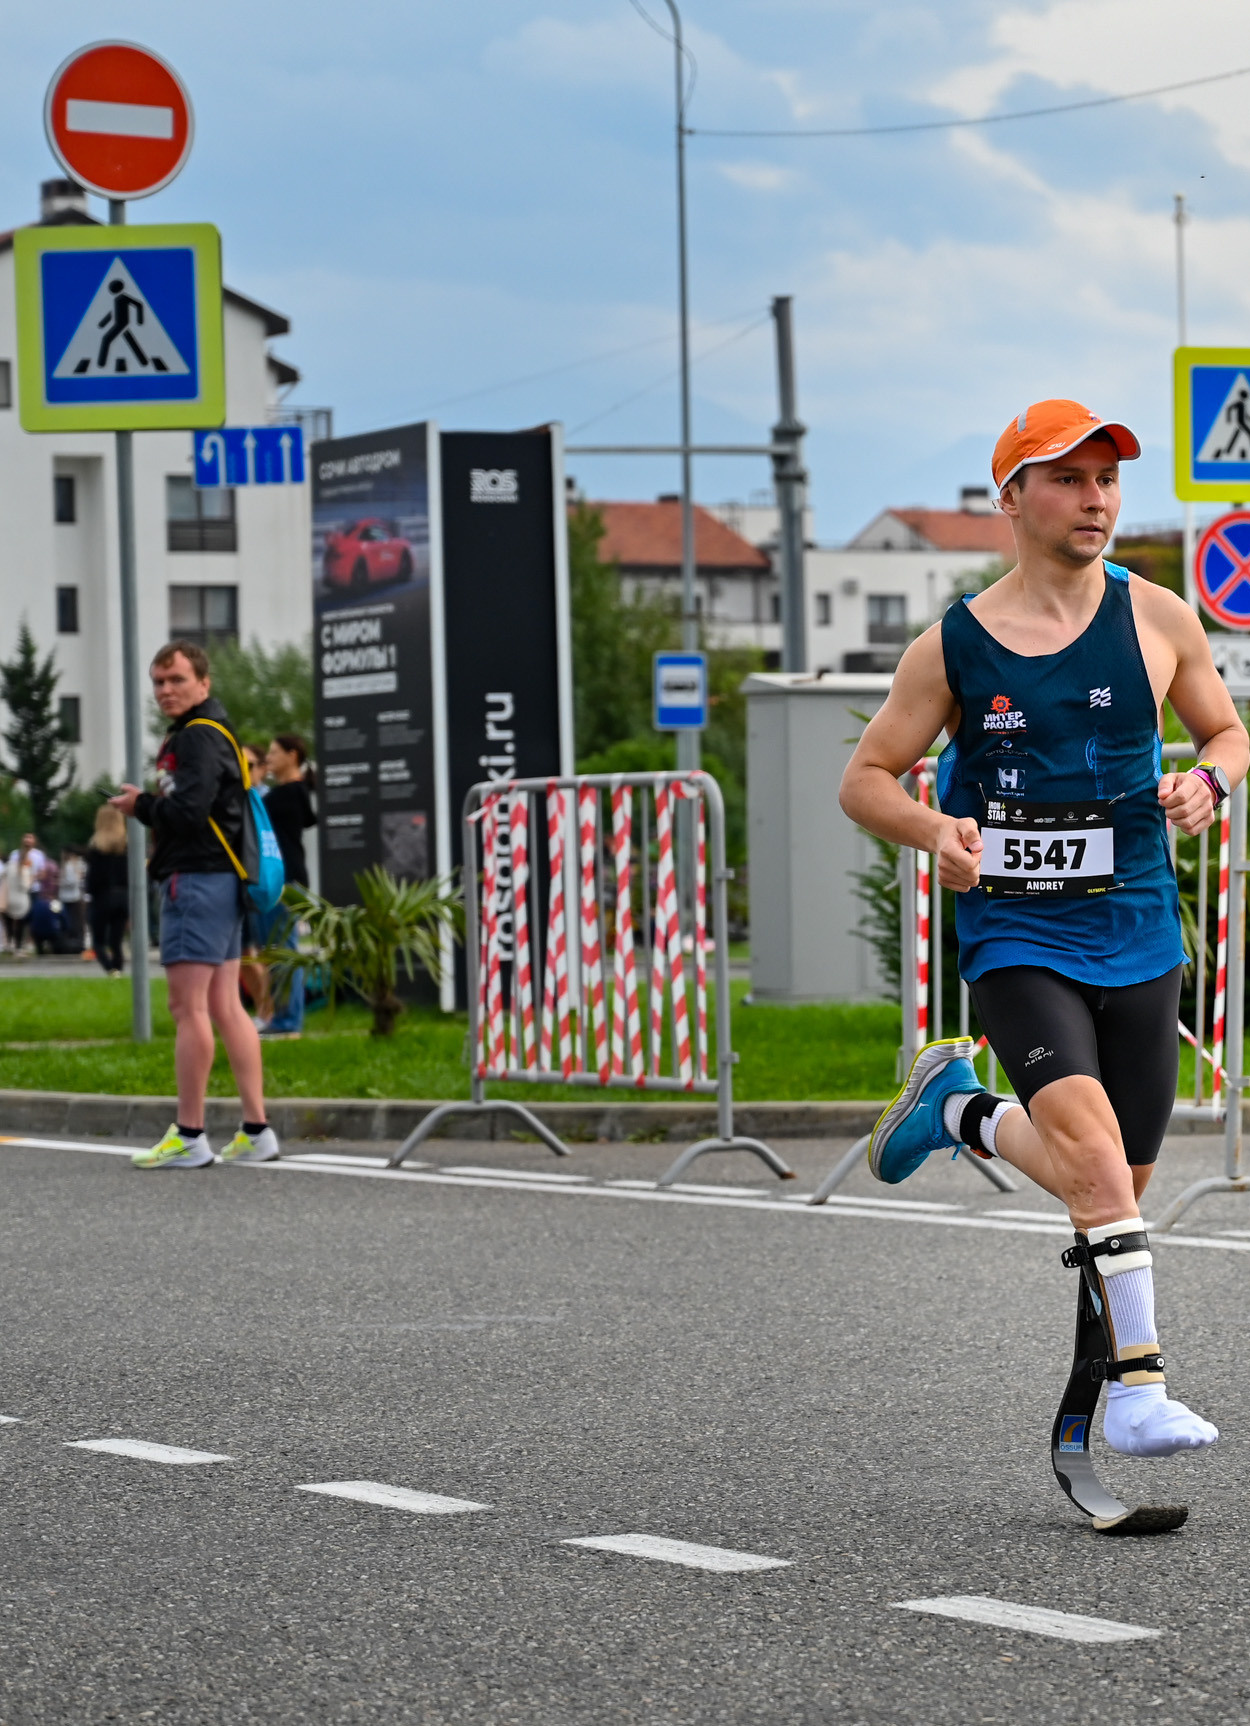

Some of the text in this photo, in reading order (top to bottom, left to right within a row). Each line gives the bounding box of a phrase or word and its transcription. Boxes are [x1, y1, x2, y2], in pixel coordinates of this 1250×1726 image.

[984, 711, 1024, 723] ИНТЕР
[987, 810, 1006, 821] STAR
[1003, 838, 1087, 870] 5547
[1026, 881, 1065, 891] ANDREY
